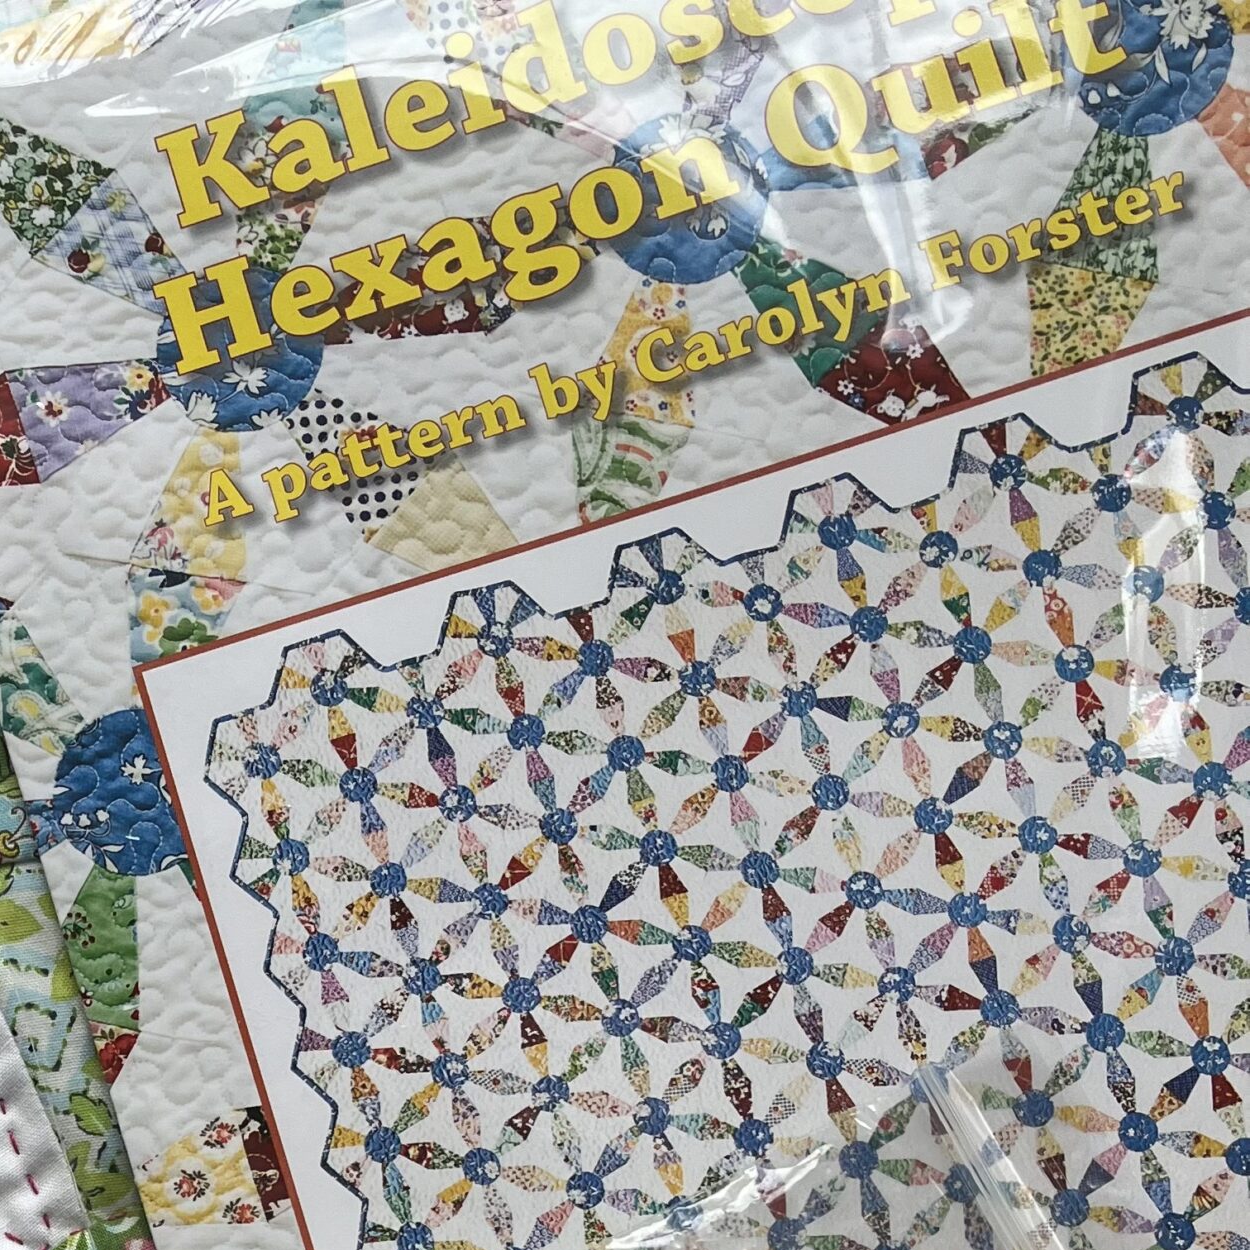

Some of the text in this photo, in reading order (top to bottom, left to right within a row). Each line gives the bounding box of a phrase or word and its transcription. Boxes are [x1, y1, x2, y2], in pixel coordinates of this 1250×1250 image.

[152, 0, 1128, 376] Hexagon Quilt
[156, 0, 936, 228] Kaleidosc
[203, 170, 1185, 527] A pattern by Carolyn Forster
